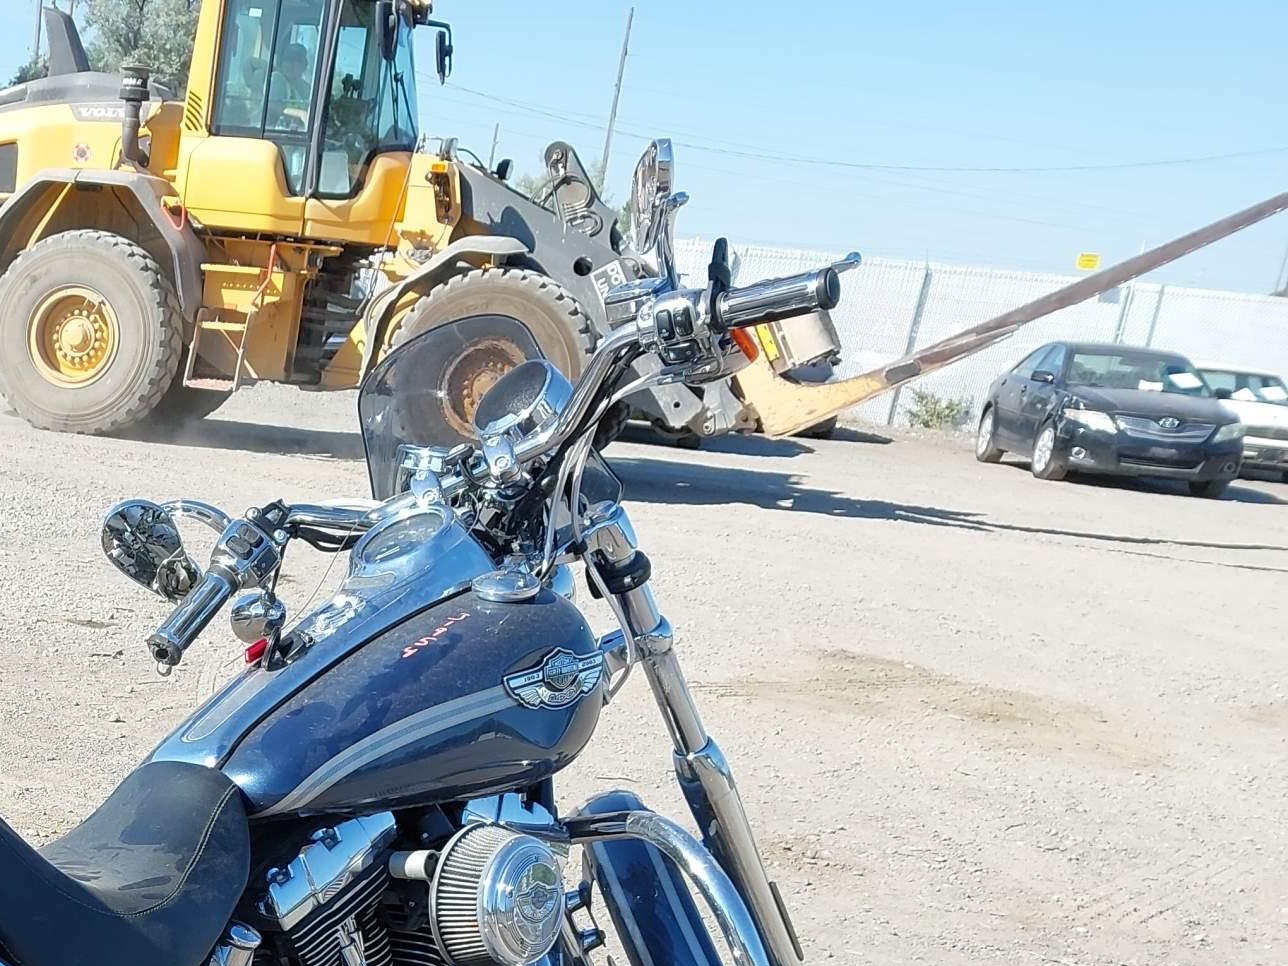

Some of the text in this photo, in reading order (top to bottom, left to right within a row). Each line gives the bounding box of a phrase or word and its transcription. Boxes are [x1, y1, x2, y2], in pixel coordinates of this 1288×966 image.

[79, 107, 125, 117] VOLV
[581, 659, 597, 667] 2003
[523, 673, 540, 682] 1903
